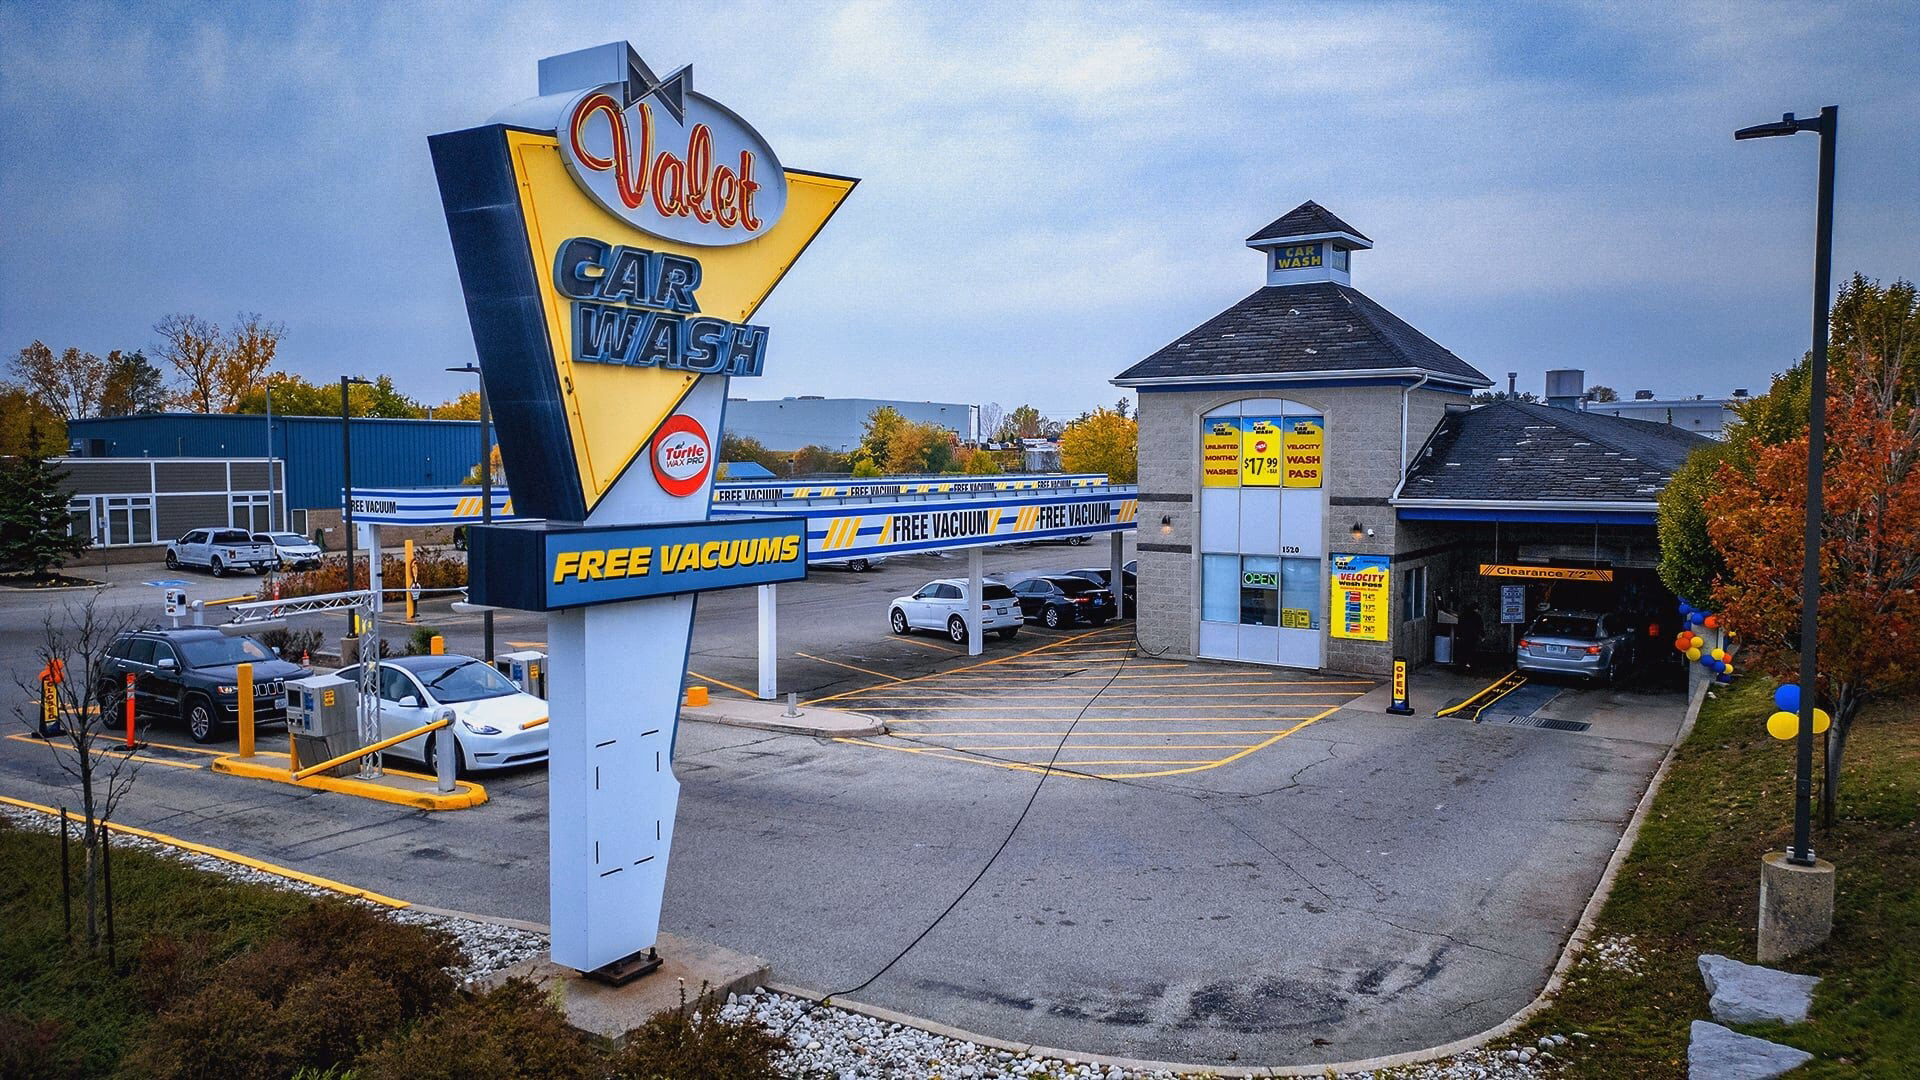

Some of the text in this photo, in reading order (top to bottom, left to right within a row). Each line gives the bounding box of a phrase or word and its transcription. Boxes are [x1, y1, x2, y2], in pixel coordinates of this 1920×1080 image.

[571, 92, 763, 232] Valet
[1286, 245, 1314, 257] CAR
[1278, 256, 1321, 268] WASH
[553, 236, 703, 314] CAR
[570, 301, 770, 377] WASH
[666, 444, 704, 460] Turtle
[666, 456, 705, 468] WAX PRO
[1287, 456, 1320, 464] WASH
[1288, 470, 1317, 478] PASS
[350, 500, 397, 514] REE VACUUM
[1039, 502, 1111, 529] FREE VACUUM
[893, 510, 989, 543] FREE VACUUM
[553, 535, 801, 584] FREE VACUUMS
[1244, 572, 1278, 586] OPEN
[1340, 573, 1385, 582] VELOCITY
[1496, 567, 1564, 578] Clearance
[1396, 665, 1404, 695] OPEN
